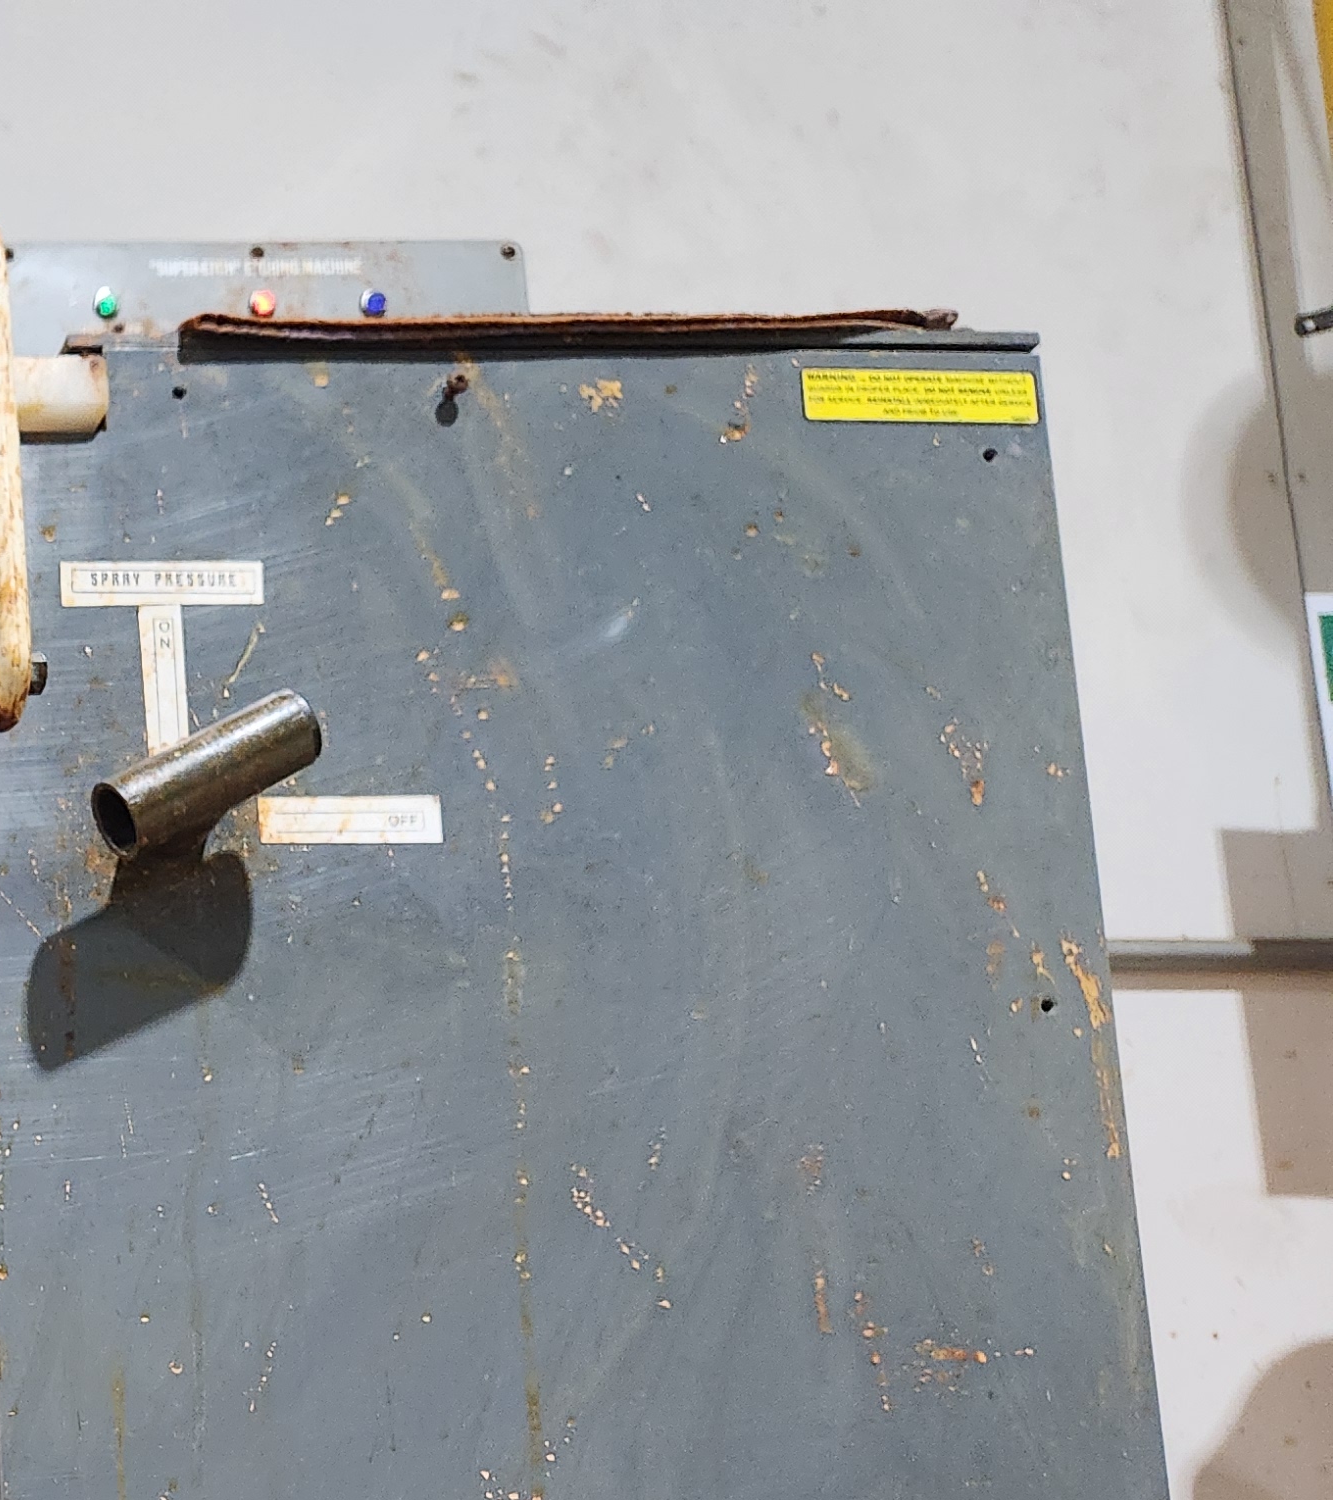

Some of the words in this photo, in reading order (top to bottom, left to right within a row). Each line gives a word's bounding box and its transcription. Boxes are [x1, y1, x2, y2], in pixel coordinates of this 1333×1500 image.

[90, 572, 140, 587] SPRAY
[154, 573, 237, 587] PRESSURE
[388, 814, 419, 828] OFF
